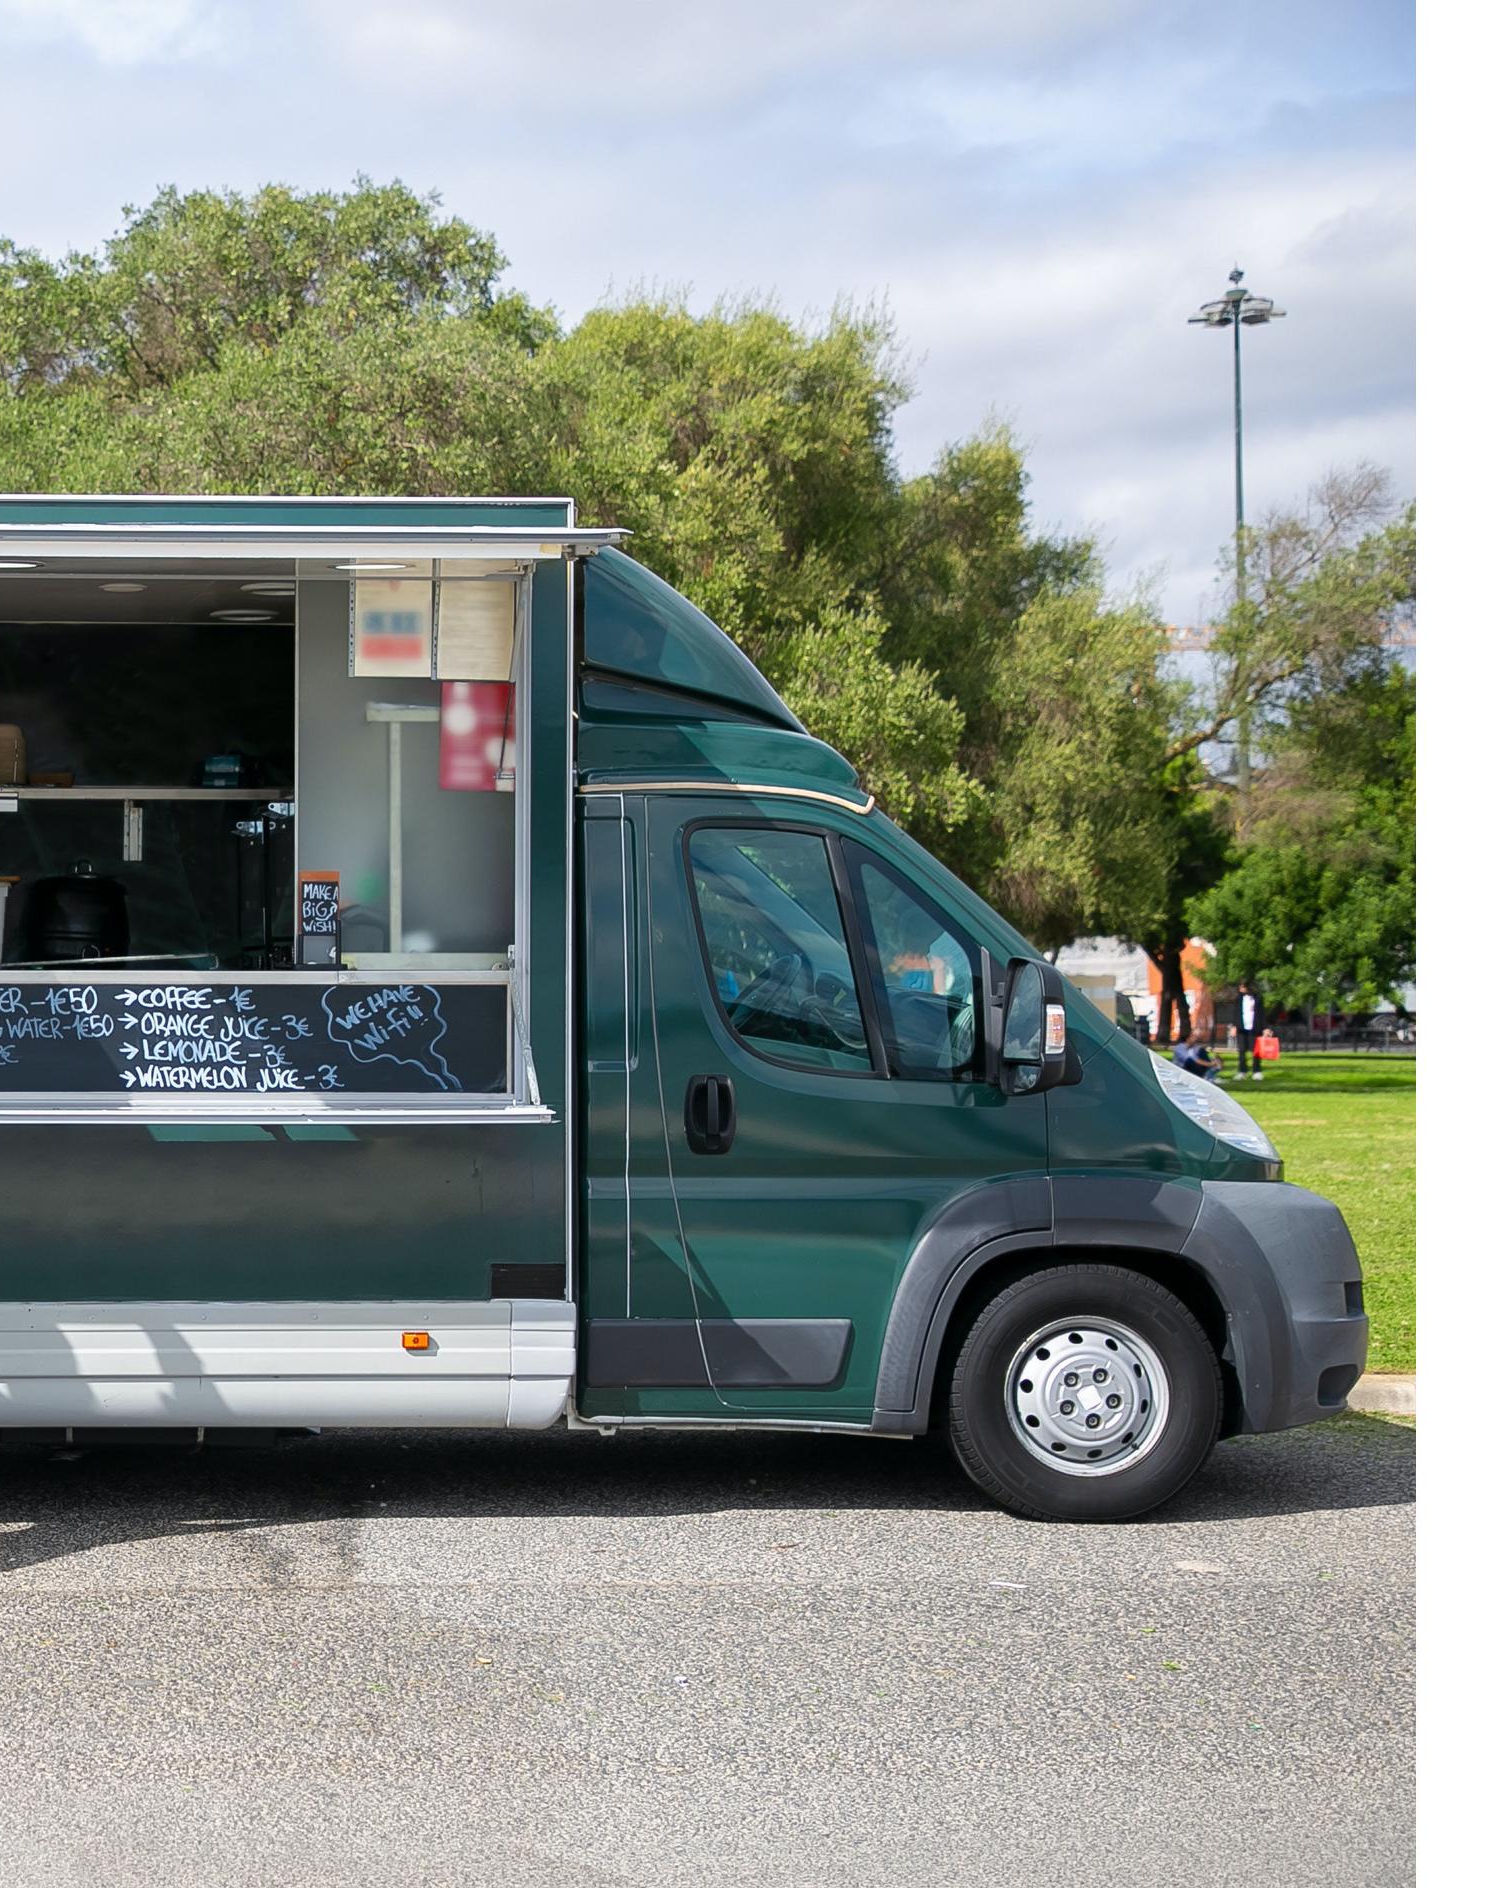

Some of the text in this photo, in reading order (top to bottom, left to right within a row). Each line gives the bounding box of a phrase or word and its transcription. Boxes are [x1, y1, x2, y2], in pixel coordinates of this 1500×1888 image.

[303, 883, 332, 901] MAKE
[137, 986, 213, 1011] COFFEE
[335, 984, 421, 1030] WE HAVE
[6, 1017, 64, 1040] WATER
[140, 1011, 215, 1040] ORANGE
[142, 1038, 248, 1065] LEMONADE
[135, 1064, 248, 1090] WATERMELON
